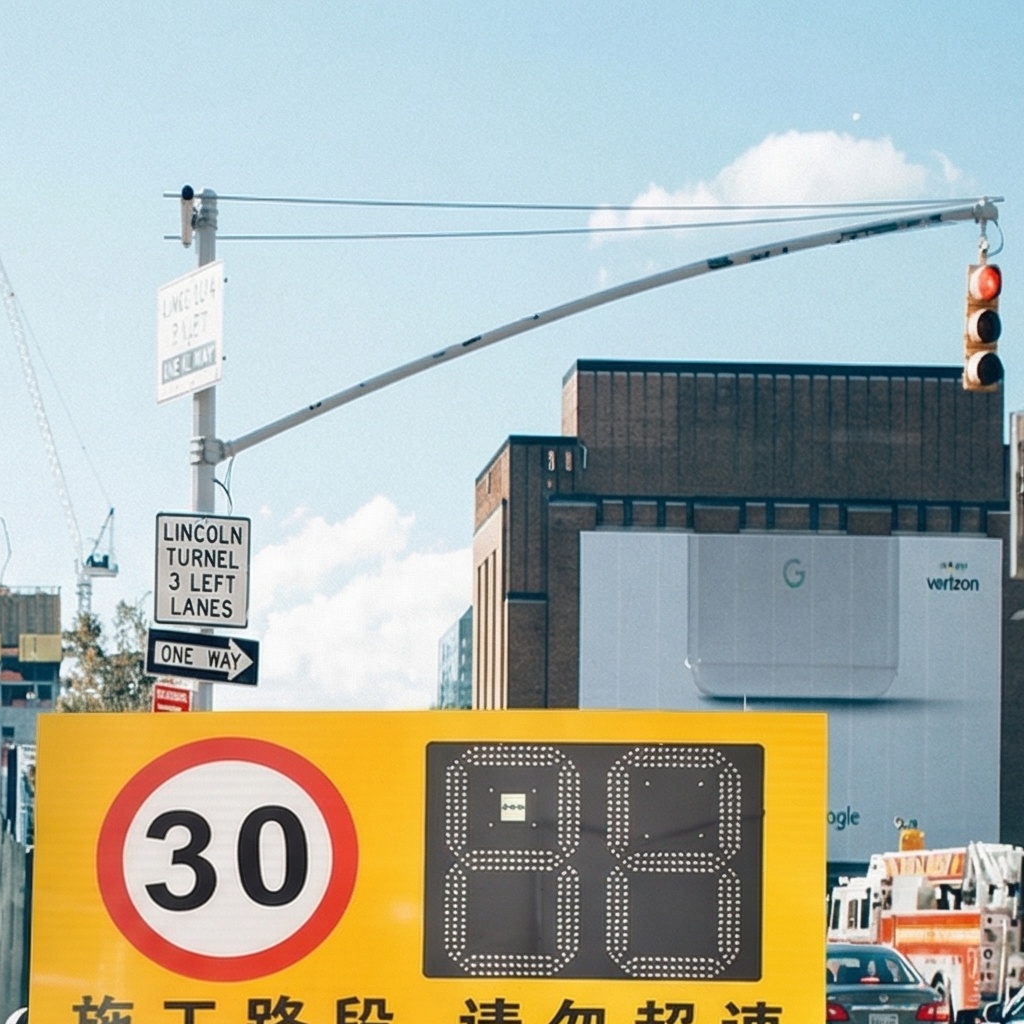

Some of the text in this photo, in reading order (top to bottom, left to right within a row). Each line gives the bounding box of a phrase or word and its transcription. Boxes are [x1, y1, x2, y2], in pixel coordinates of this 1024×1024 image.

[164, 523, 242, 545] LINCOLN
[166, 547, 239, 569] TURNEL
[169, 572, 236, 593] 3 LEFT
[783, 558, 805, 588] G
[171, 597, 233, 618] LANES
[161, 645, 242, 670] ONE WAY
[827, 805, 860, 831] ogle
[145, 805, 308, 912] 30
